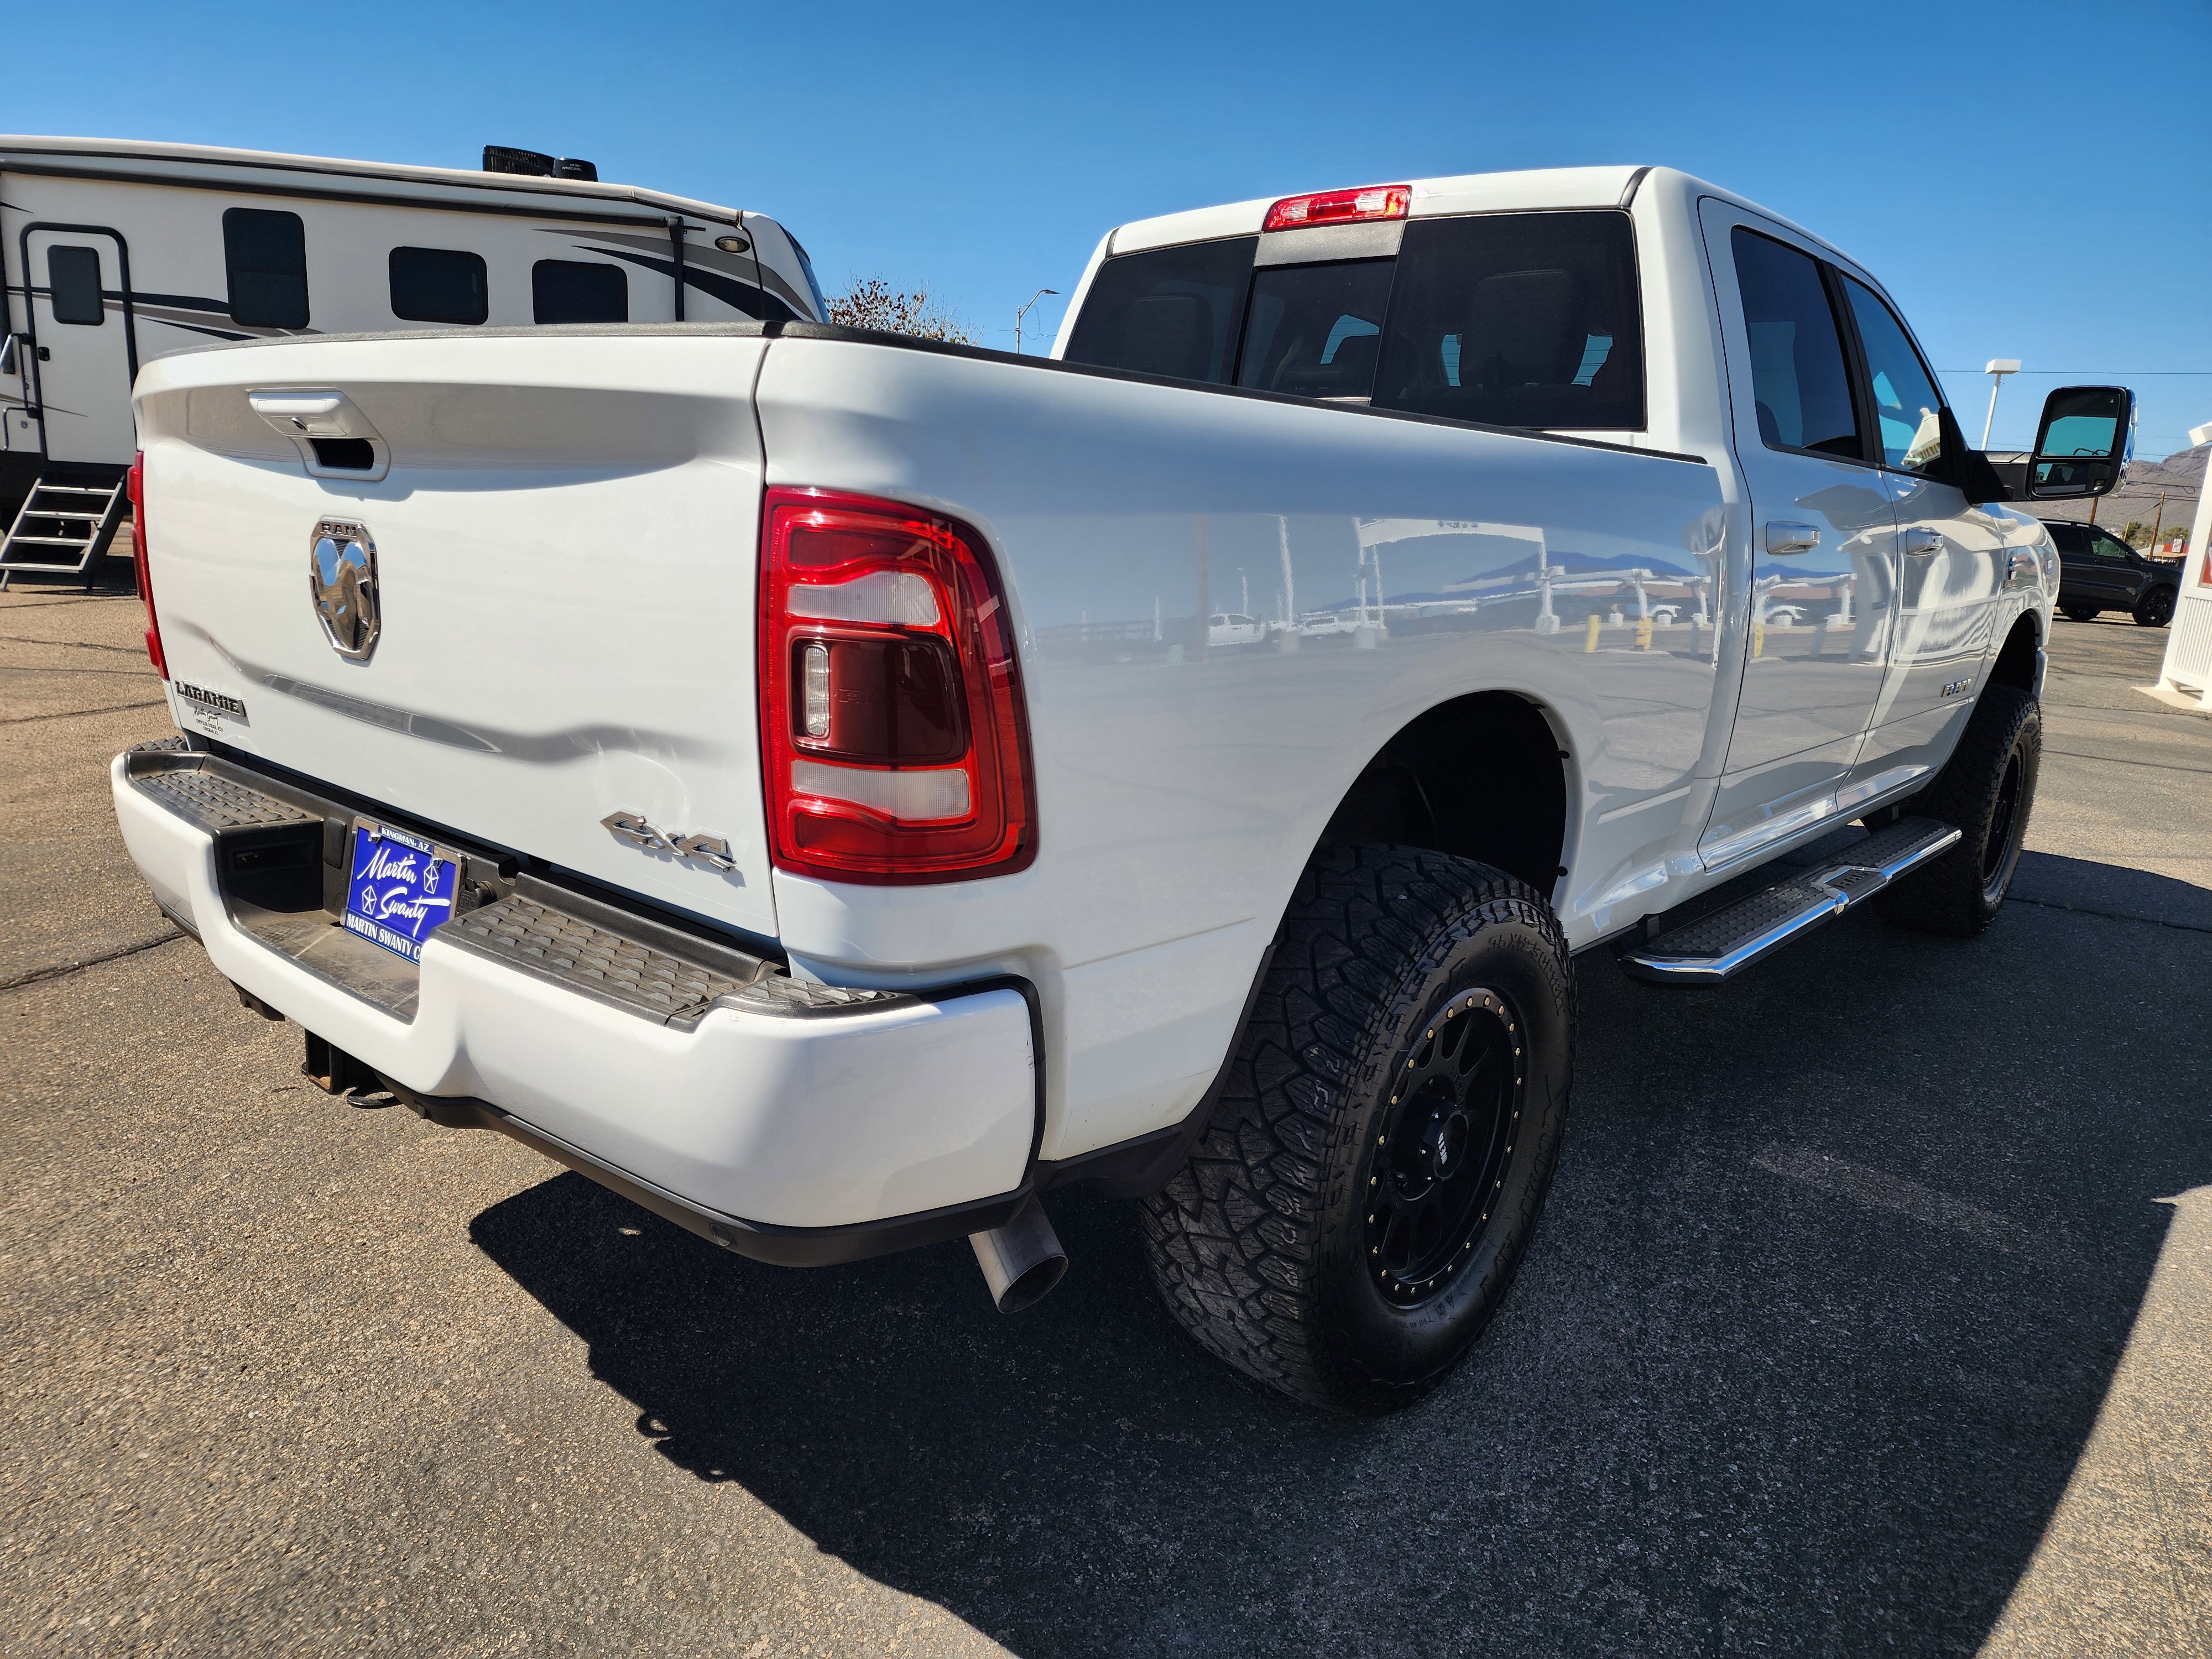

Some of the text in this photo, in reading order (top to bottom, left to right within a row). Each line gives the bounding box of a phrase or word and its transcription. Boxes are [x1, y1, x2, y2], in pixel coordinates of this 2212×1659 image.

[320, 523, 357, 538] RAM
[175, 680, 240, 714] LARAMIE
[381, 827, 430, 852] KINGMAN, AZ
[357, 846, 417, 884] Martin
[375, 886, 451, 938] Swanty
[347, 914, 378, 940] MARTIN
[378, 928, 413, 957] SWANTY
